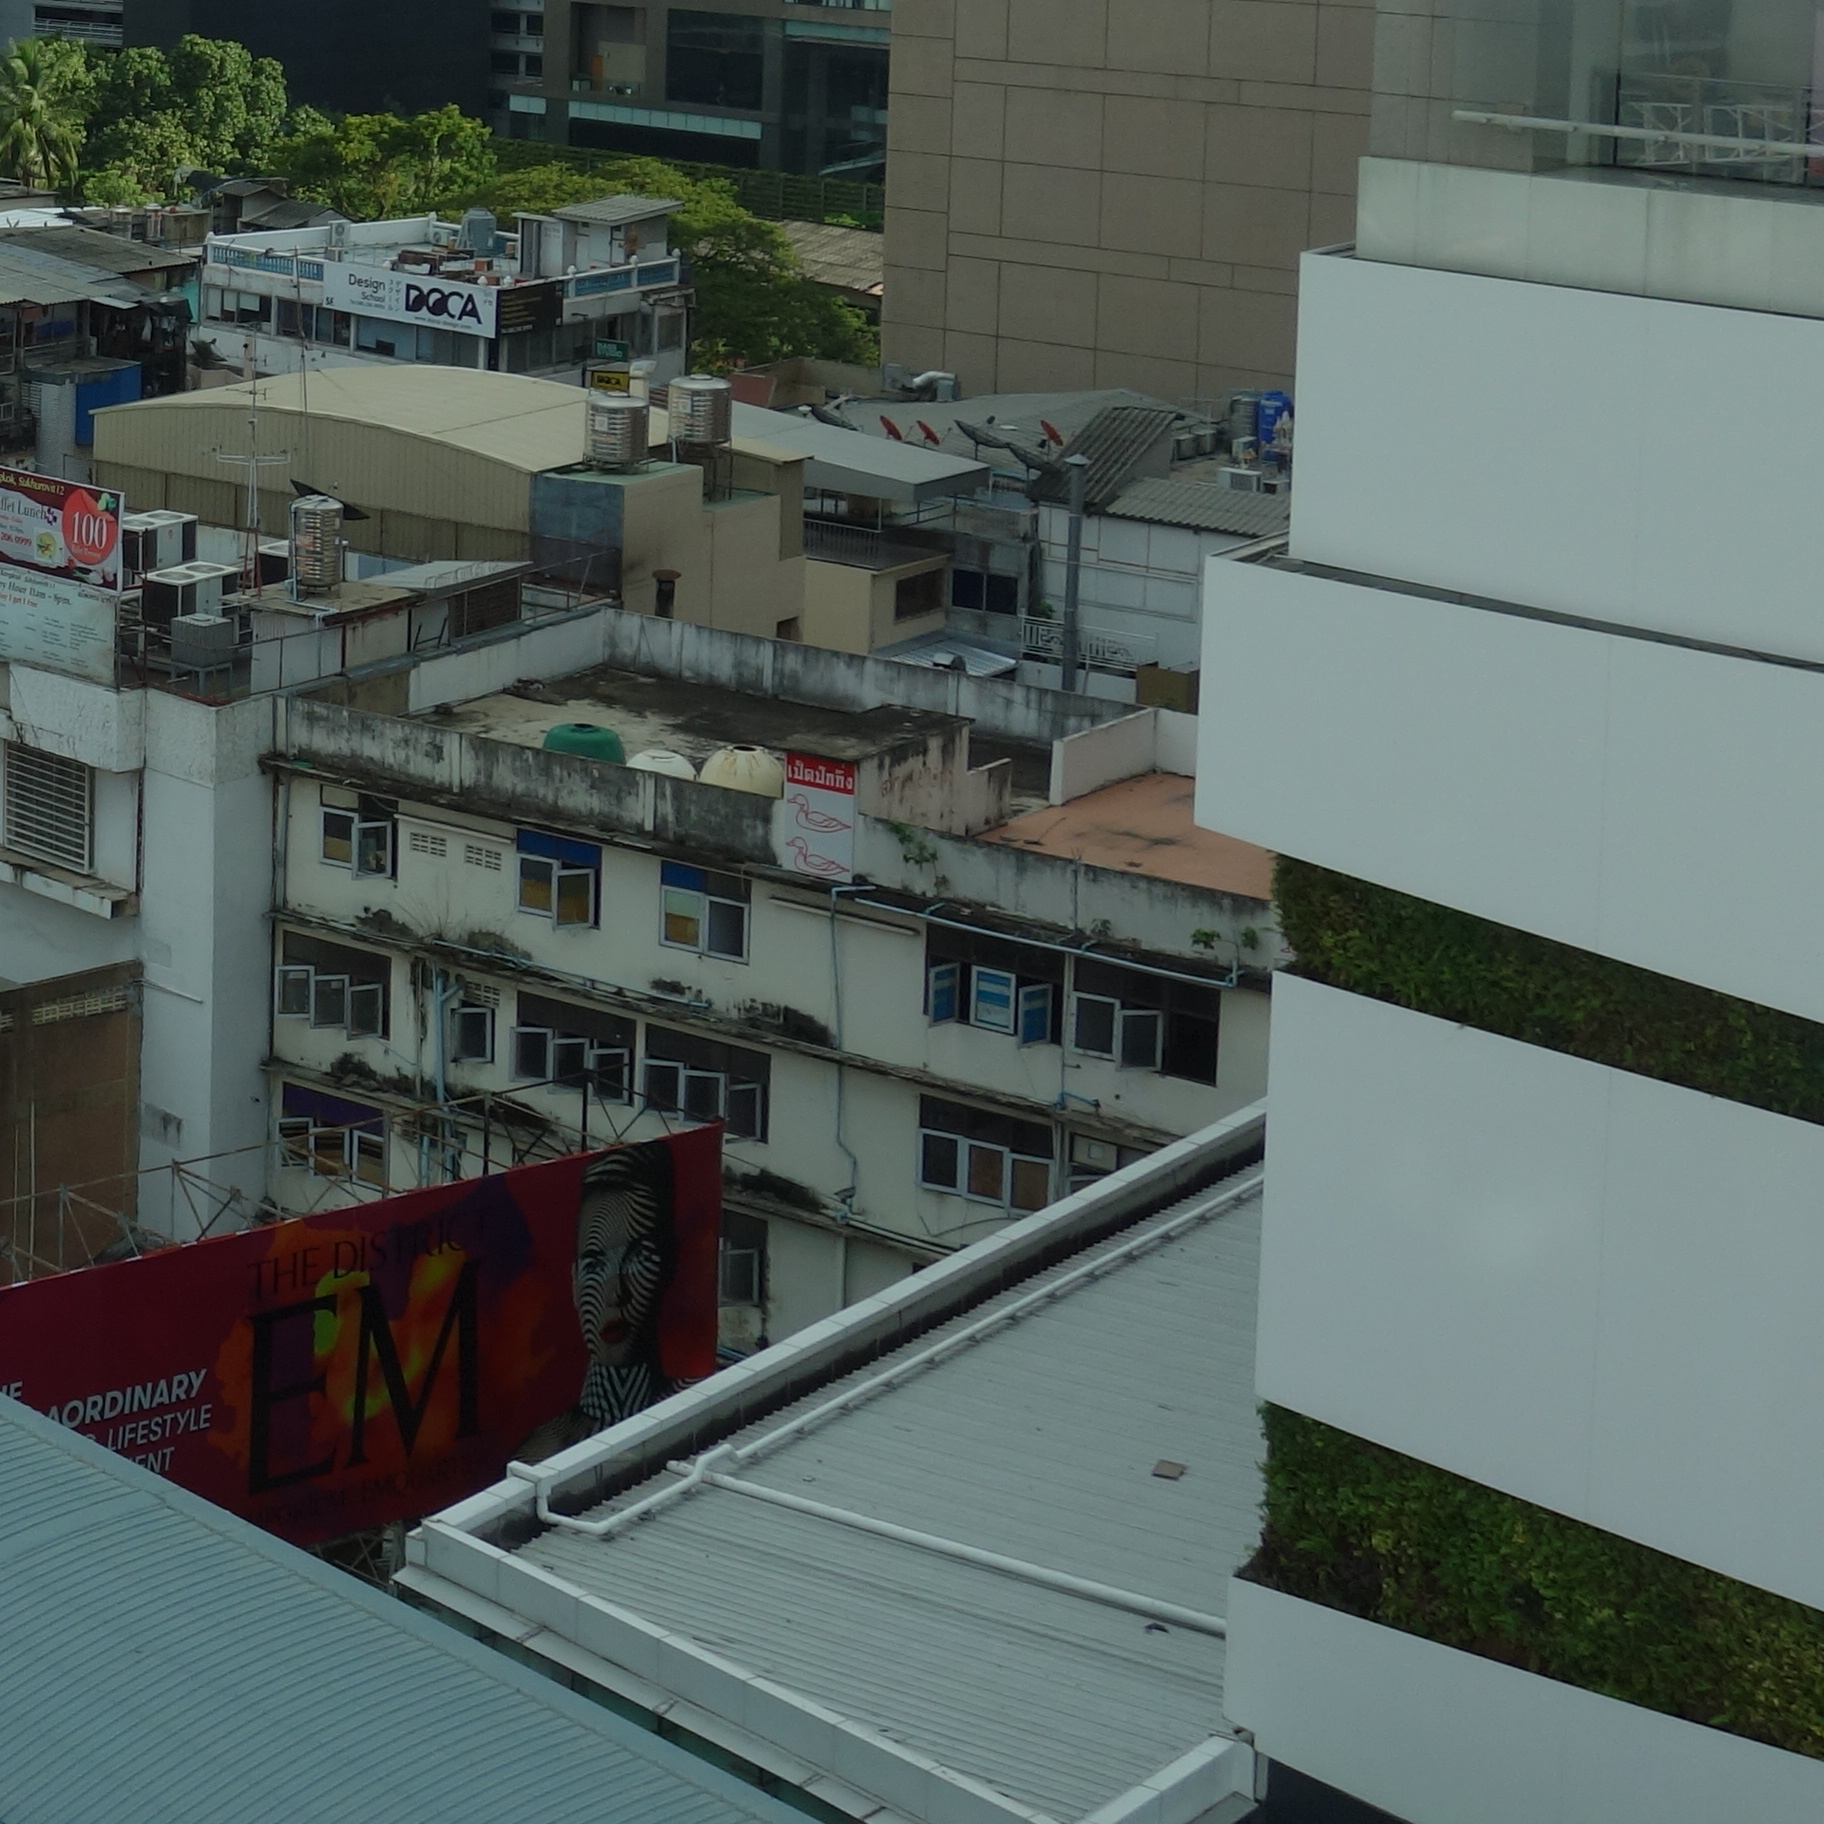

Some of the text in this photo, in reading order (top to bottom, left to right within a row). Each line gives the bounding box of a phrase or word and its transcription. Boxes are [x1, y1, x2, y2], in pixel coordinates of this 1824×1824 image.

[348, 273, 385, 294] Design
[361, 291, 385, 303] School
[17, 499, 48, 521] Lunch
[73, 511, 107, 549] 100
[8, 578, 27, 595] Hour
[787, 759, 853, 790] เป็ดปักกิ่ง
[248, 1216, 488, 1299] THE DISTRICT
[248, 1259, 481, 1496] EM
[46, 1368, 208, 1429] AORDINARY
[108, 1404, 212, 1451] LIFESTYLE
